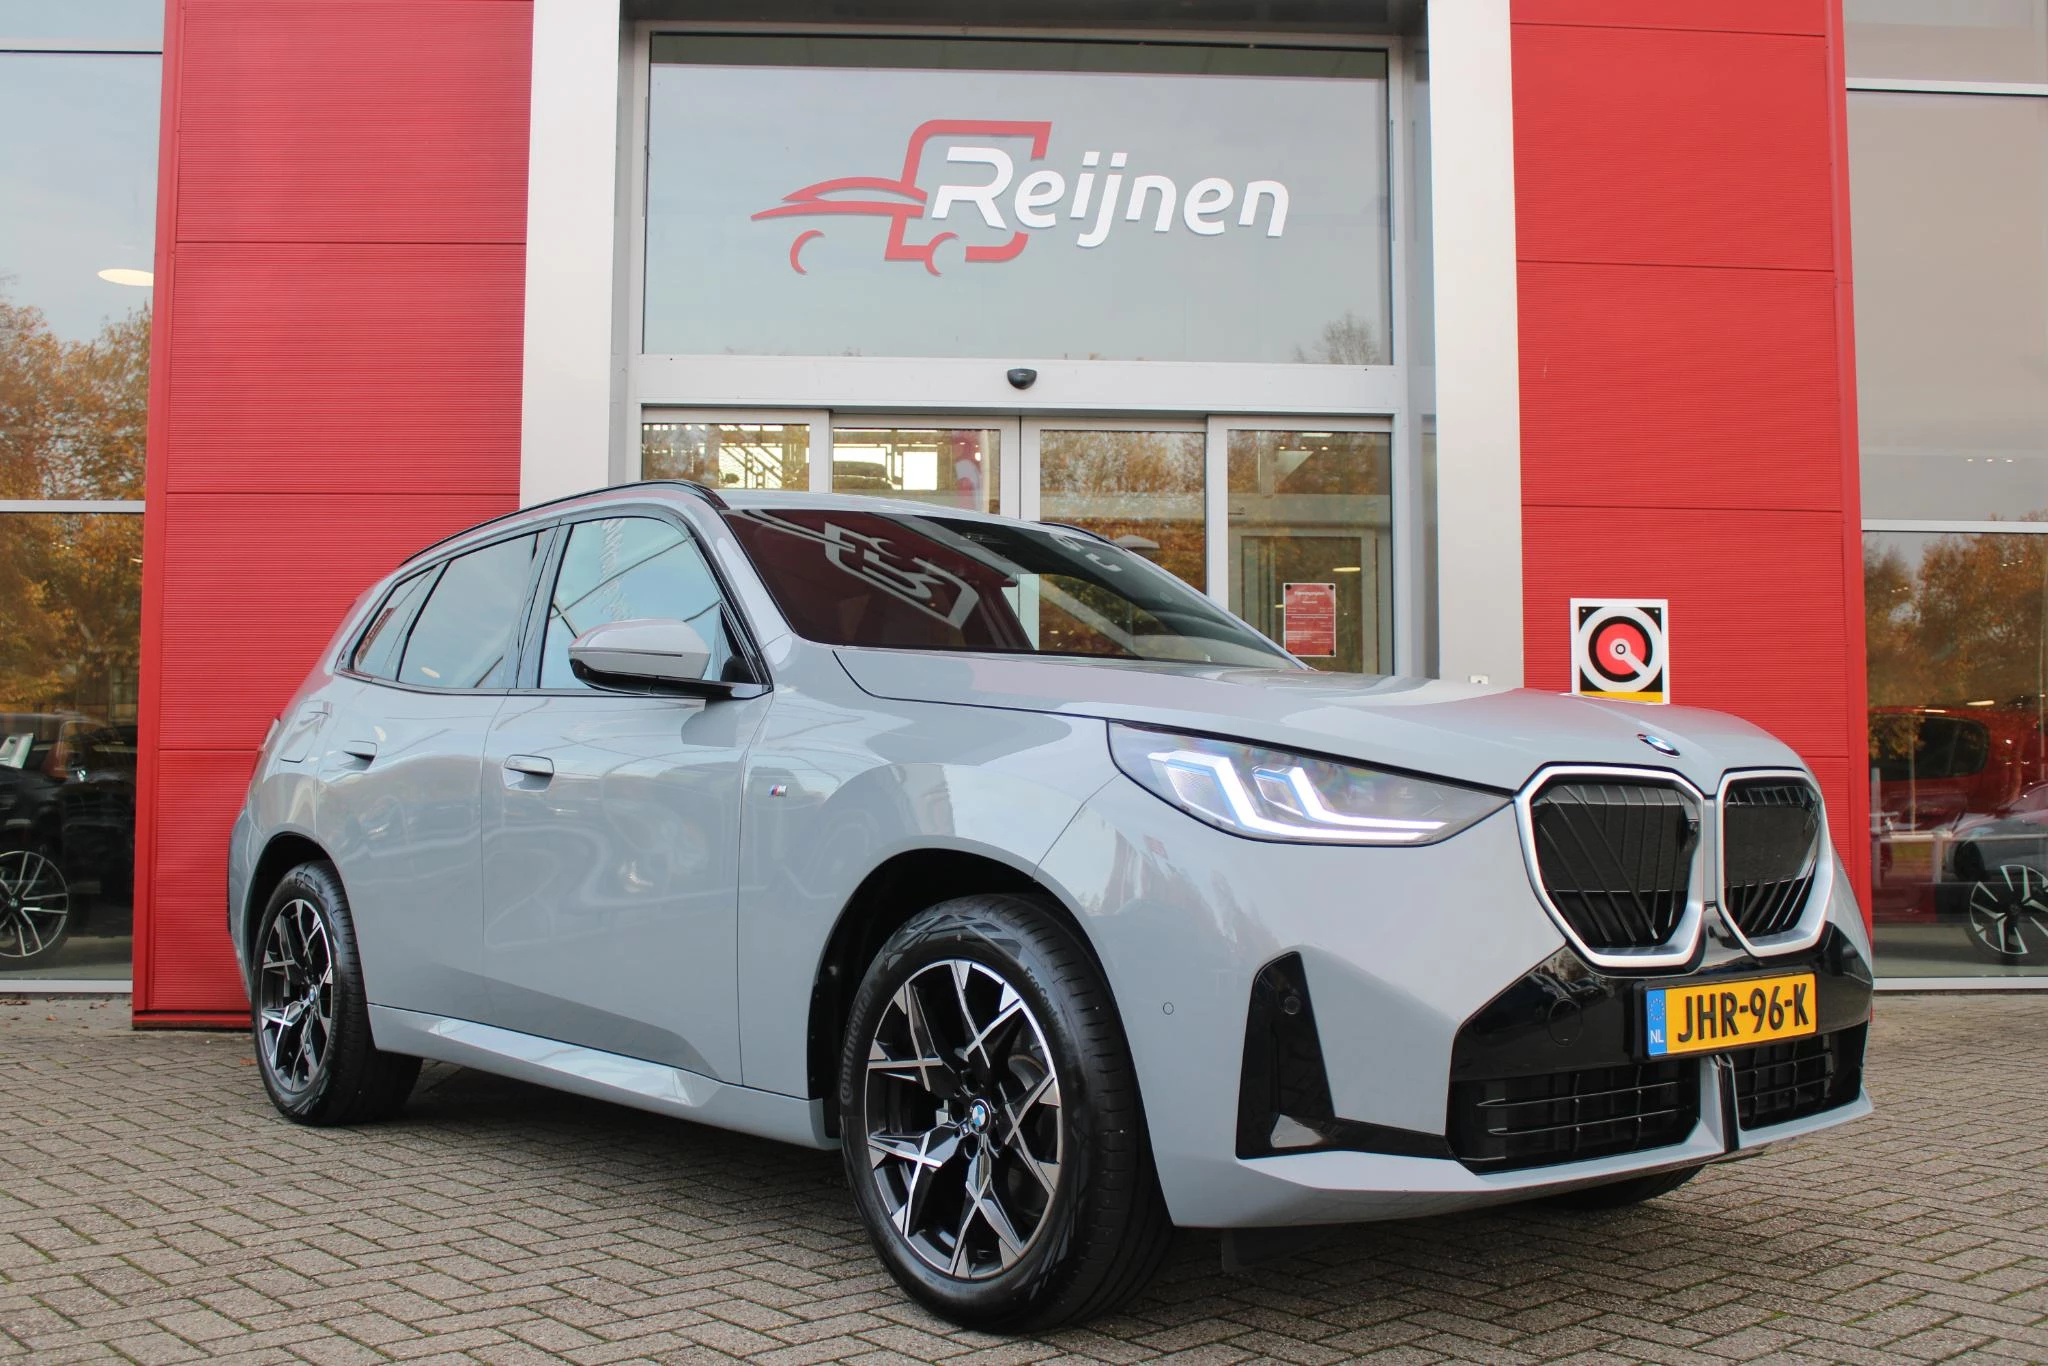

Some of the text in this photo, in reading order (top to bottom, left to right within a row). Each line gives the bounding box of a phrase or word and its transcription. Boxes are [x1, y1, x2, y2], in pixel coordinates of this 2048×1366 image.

[931, 147, 1290, 248] Reijnen
[1650, 1028, 1665, 1044] NL
[1678, 983, 1809, 1042] JHR-96-K
